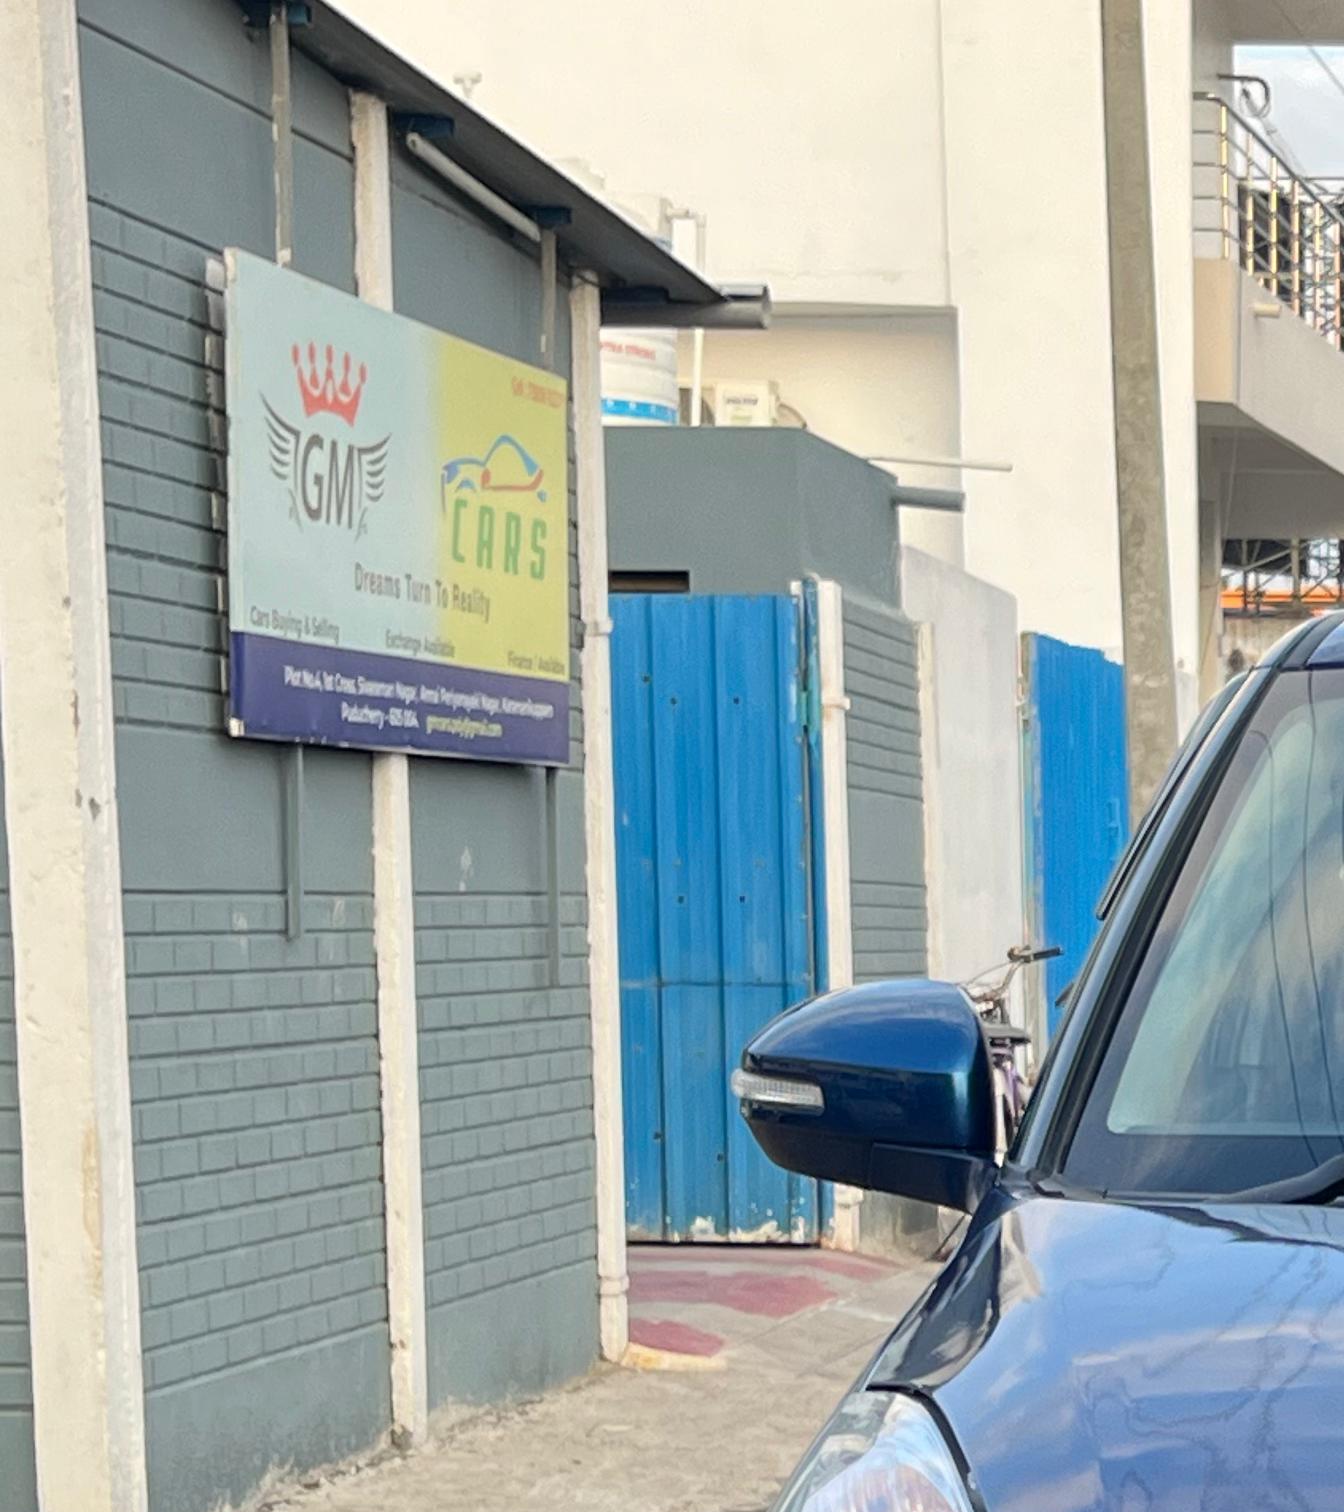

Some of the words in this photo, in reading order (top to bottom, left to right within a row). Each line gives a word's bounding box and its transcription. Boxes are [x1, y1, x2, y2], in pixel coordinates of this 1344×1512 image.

[302, 433, 354, 530] GM
[452, 499, 547, 581] CARS
[250, 605, 270, 630] Cars
[272, 608, 302, 639] Buying
[312, 616, 340, 645] Selling
[354, 561, 400, 600] Dreams
[404, 572, 431, 605] Turn
[434, 579, 449, 609] To
[452, 583, 490, 624] Reality
